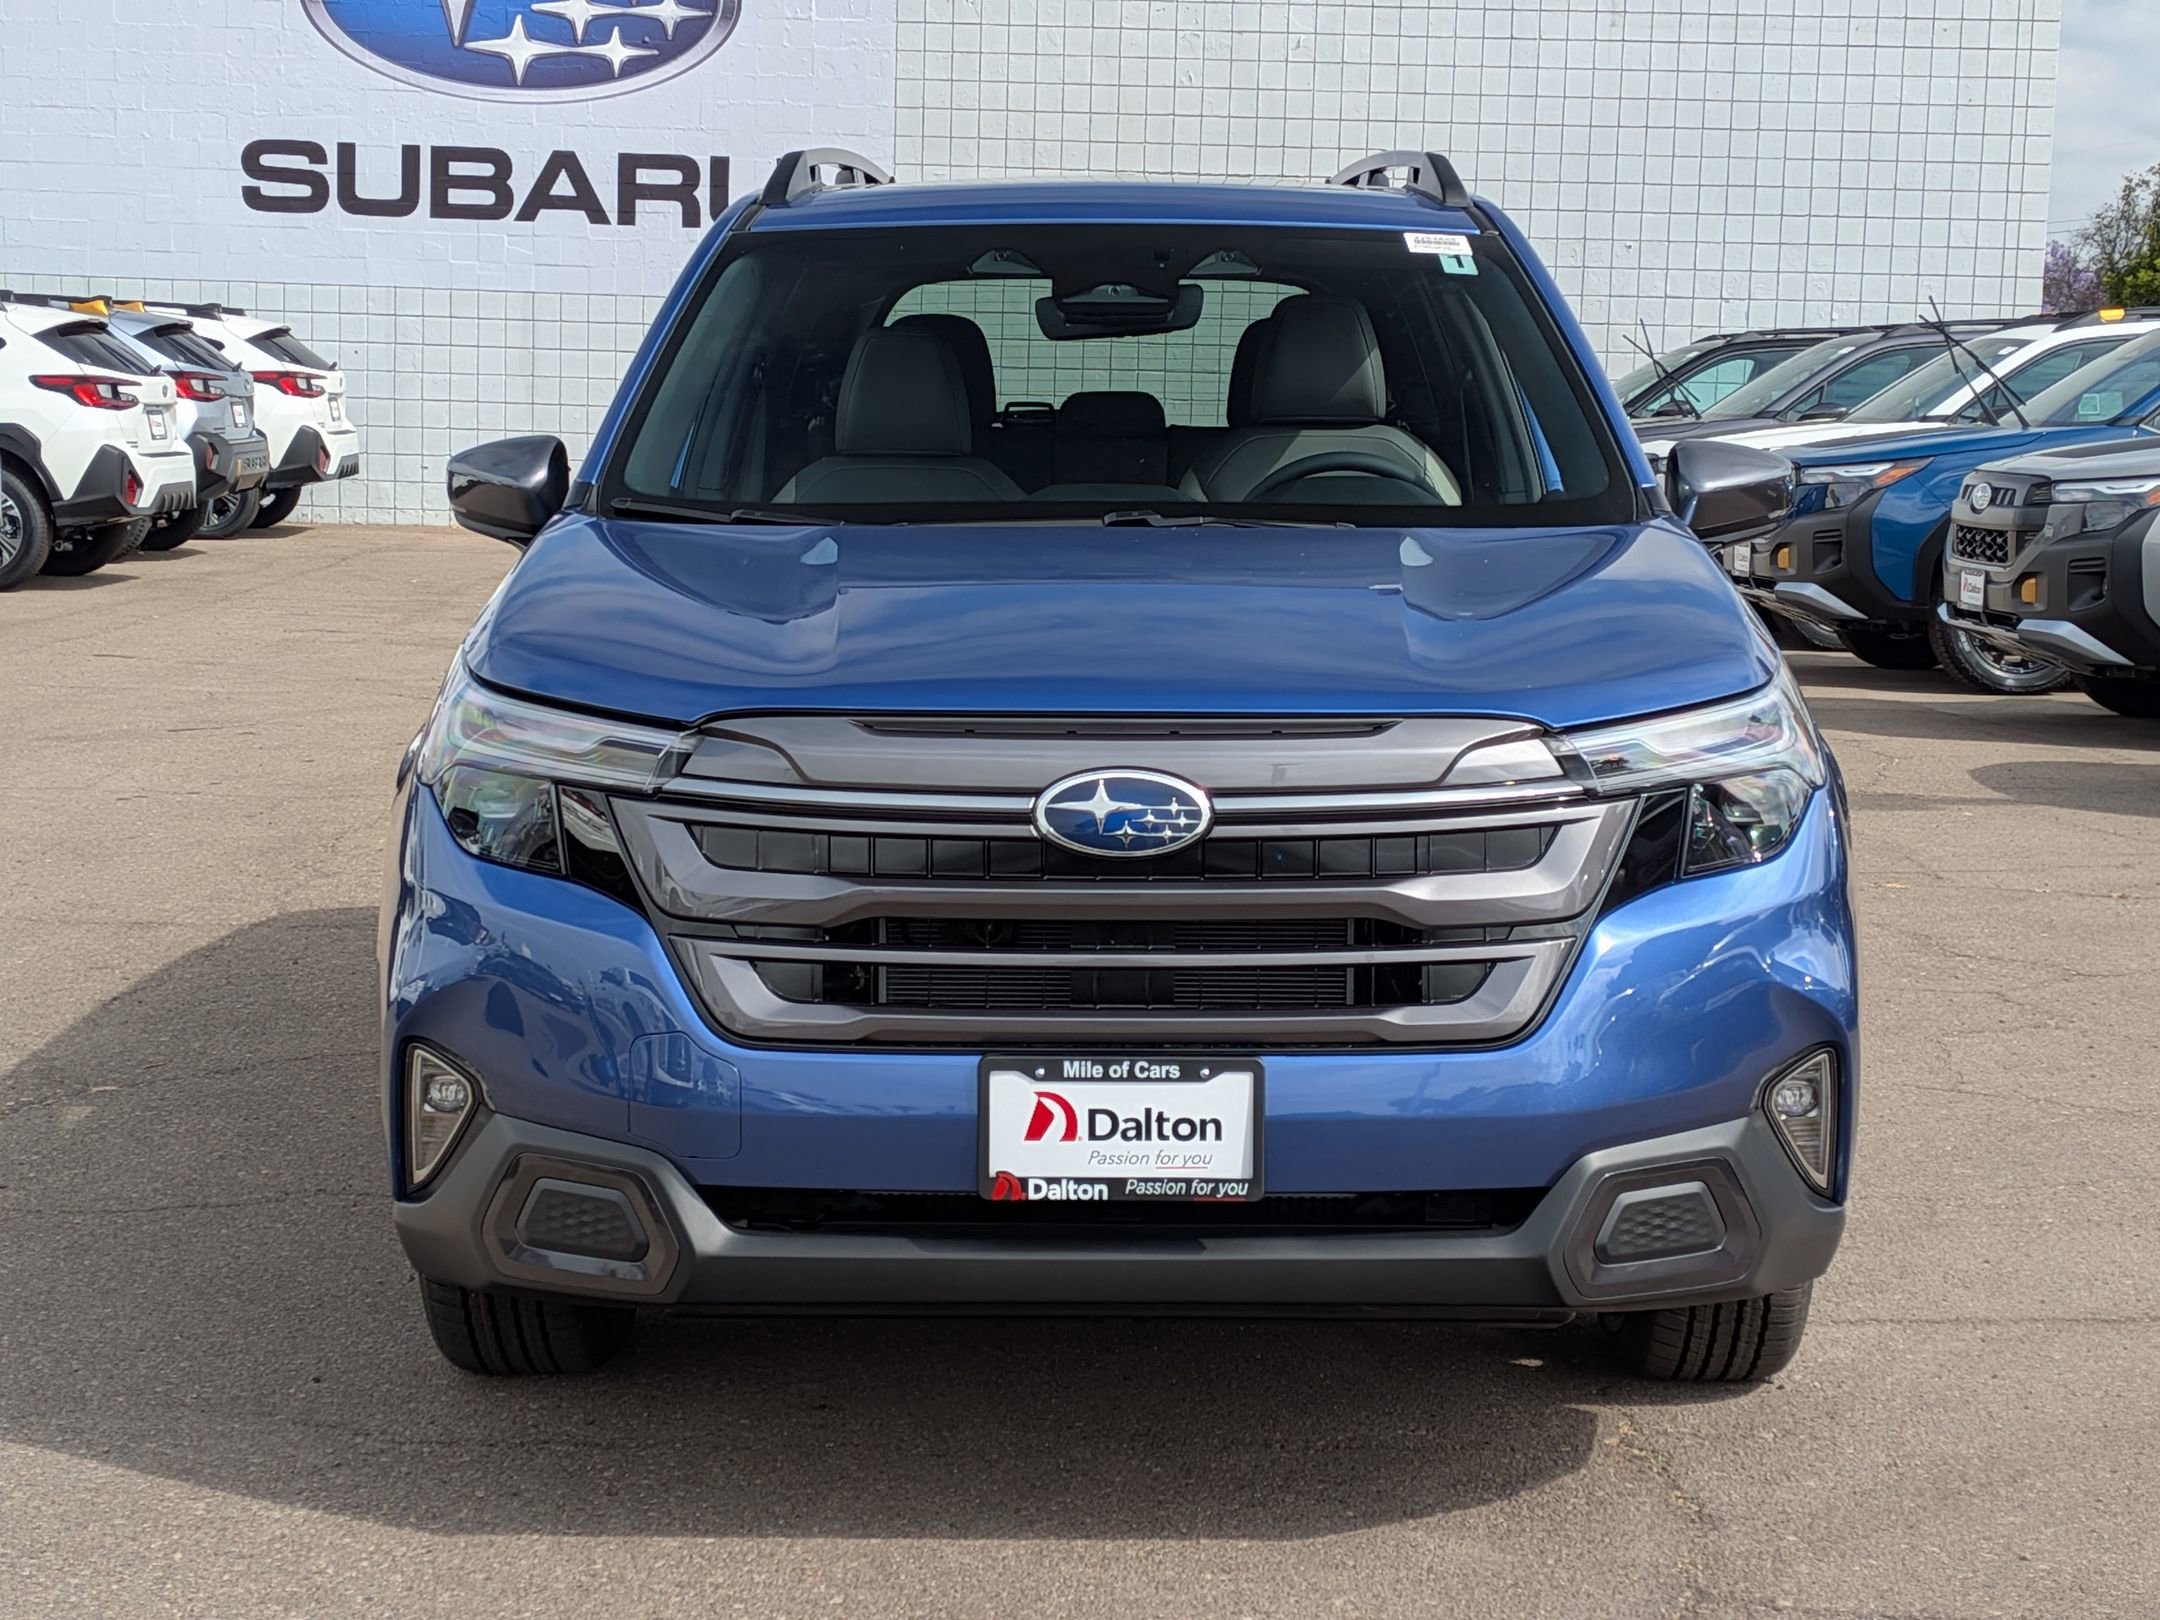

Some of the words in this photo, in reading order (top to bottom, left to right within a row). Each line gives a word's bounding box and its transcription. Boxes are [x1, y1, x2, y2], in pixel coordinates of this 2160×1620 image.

[1063, 1061, 1104, 1078] Mile
[1109, 1061, 1130, 1078] of
[1134, 1061, 1181, 1079] Cars
[1087, 1107, 1223, 1142] Dalton
[1087, 1150, 1150, 1165] Passion
[1154, 1149, 1179, 1166] for
[1182, 1153, 1213, 1168] you
[1028, 1178, 1109, 1201] Dalton
[1124, 1178, 1187, 1196] Passion
[1190, 1179, 1215, 1196] for
[1215, 1182, 1249, 1199] you
